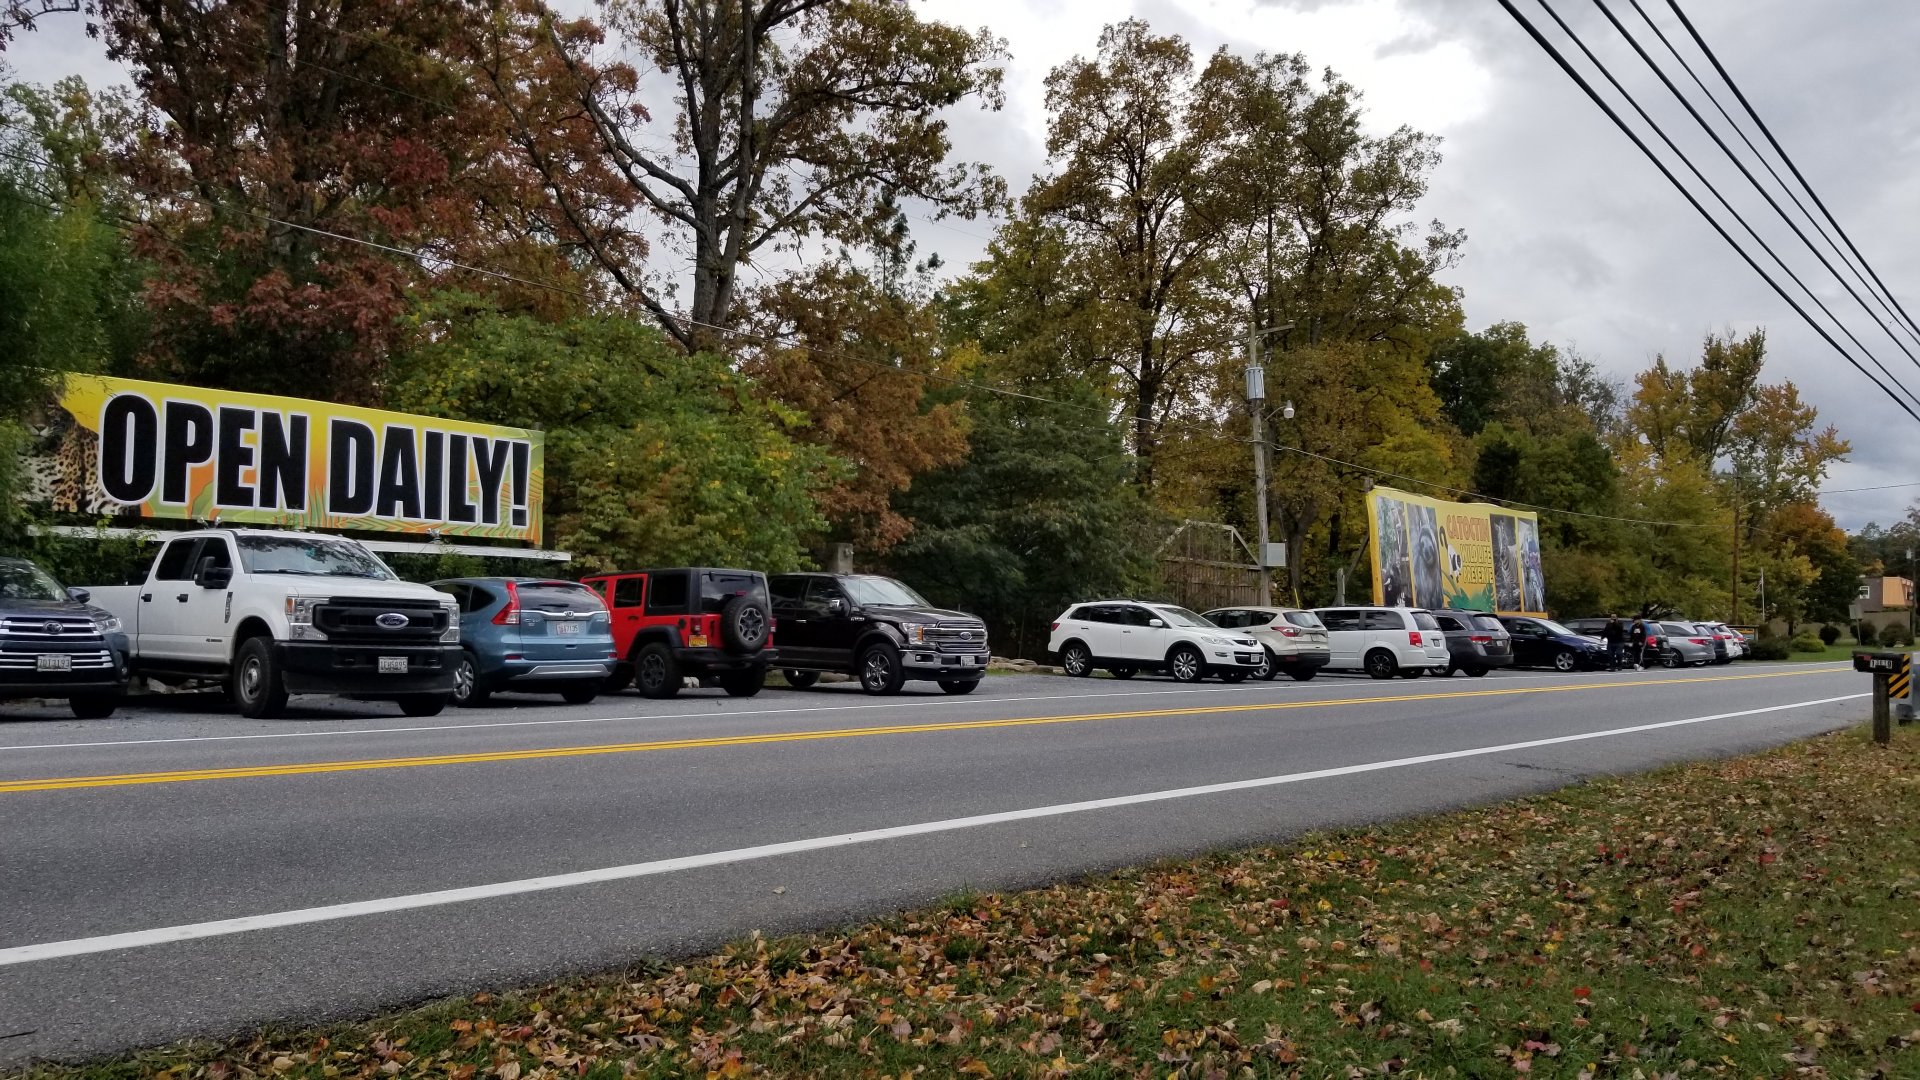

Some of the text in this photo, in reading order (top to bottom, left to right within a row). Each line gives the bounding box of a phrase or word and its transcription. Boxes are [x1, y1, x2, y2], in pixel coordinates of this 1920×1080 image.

[101, 393, 530, 527] OPEN DAILY!
[1446, 514, 1490, 542] CATOCTIN
[1459, 543, 1492, 565] WILDLIFE
[1463, 565, 1494, 585] PRESERVE
